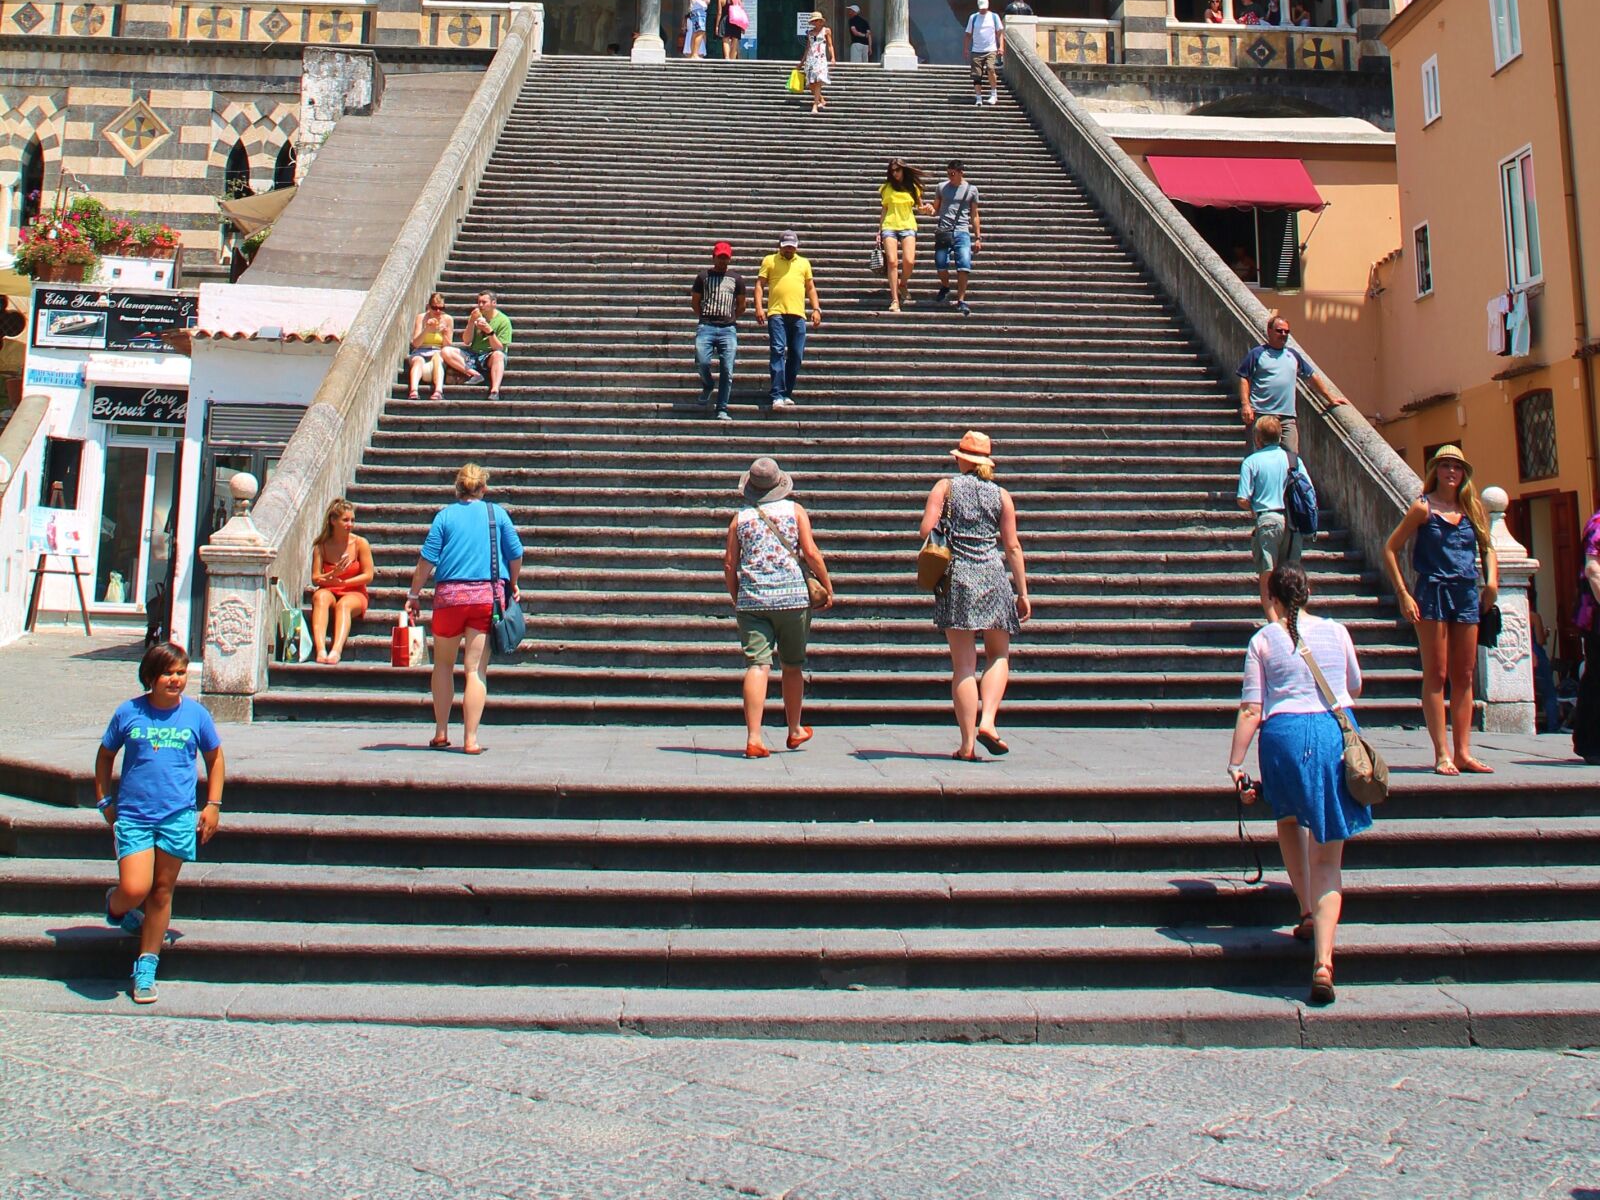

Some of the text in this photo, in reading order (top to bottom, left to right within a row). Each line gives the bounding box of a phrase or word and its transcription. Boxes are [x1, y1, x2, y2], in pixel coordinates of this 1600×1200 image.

[44, 292, 69, 306] Elite
[92, 396, 146, 420] Bijoux
[153, 407, 162, 419] &
[140, 388, 178, 409] Cosy
